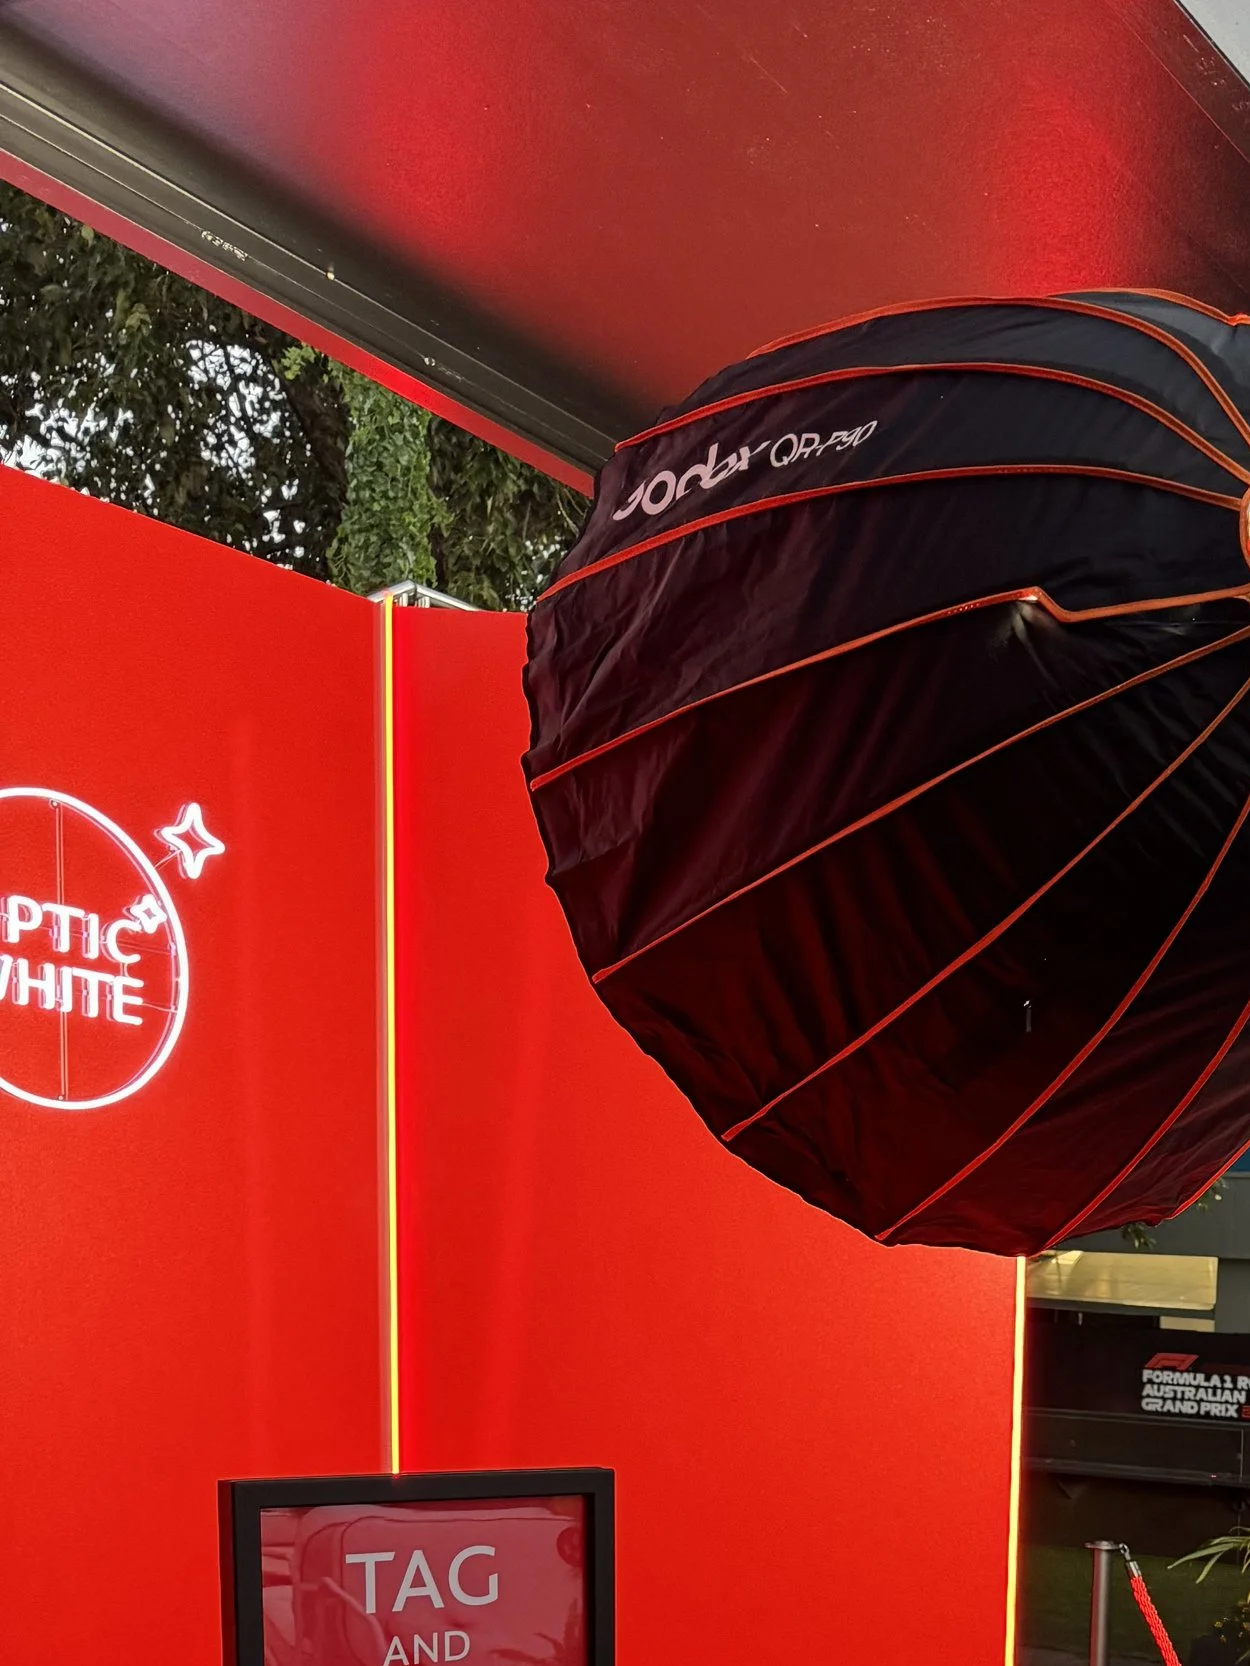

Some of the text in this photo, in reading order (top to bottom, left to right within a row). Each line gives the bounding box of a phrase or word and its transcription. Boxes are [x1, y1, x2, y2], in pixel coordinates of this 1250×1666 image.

[3, 895, 141, 964] PTIC
[1142, 1369, 1221, 1388] FORMULA
[1223, 1374, 1234, 1388] 1
[1142, 1383, 1247, 1404] AUSTRALIAN
[1141, 1397, 1199, 1415] GRAND
[1199, 1402, 1239, 1418] PRIX
[345, 1545, 499, 1614] TAG
